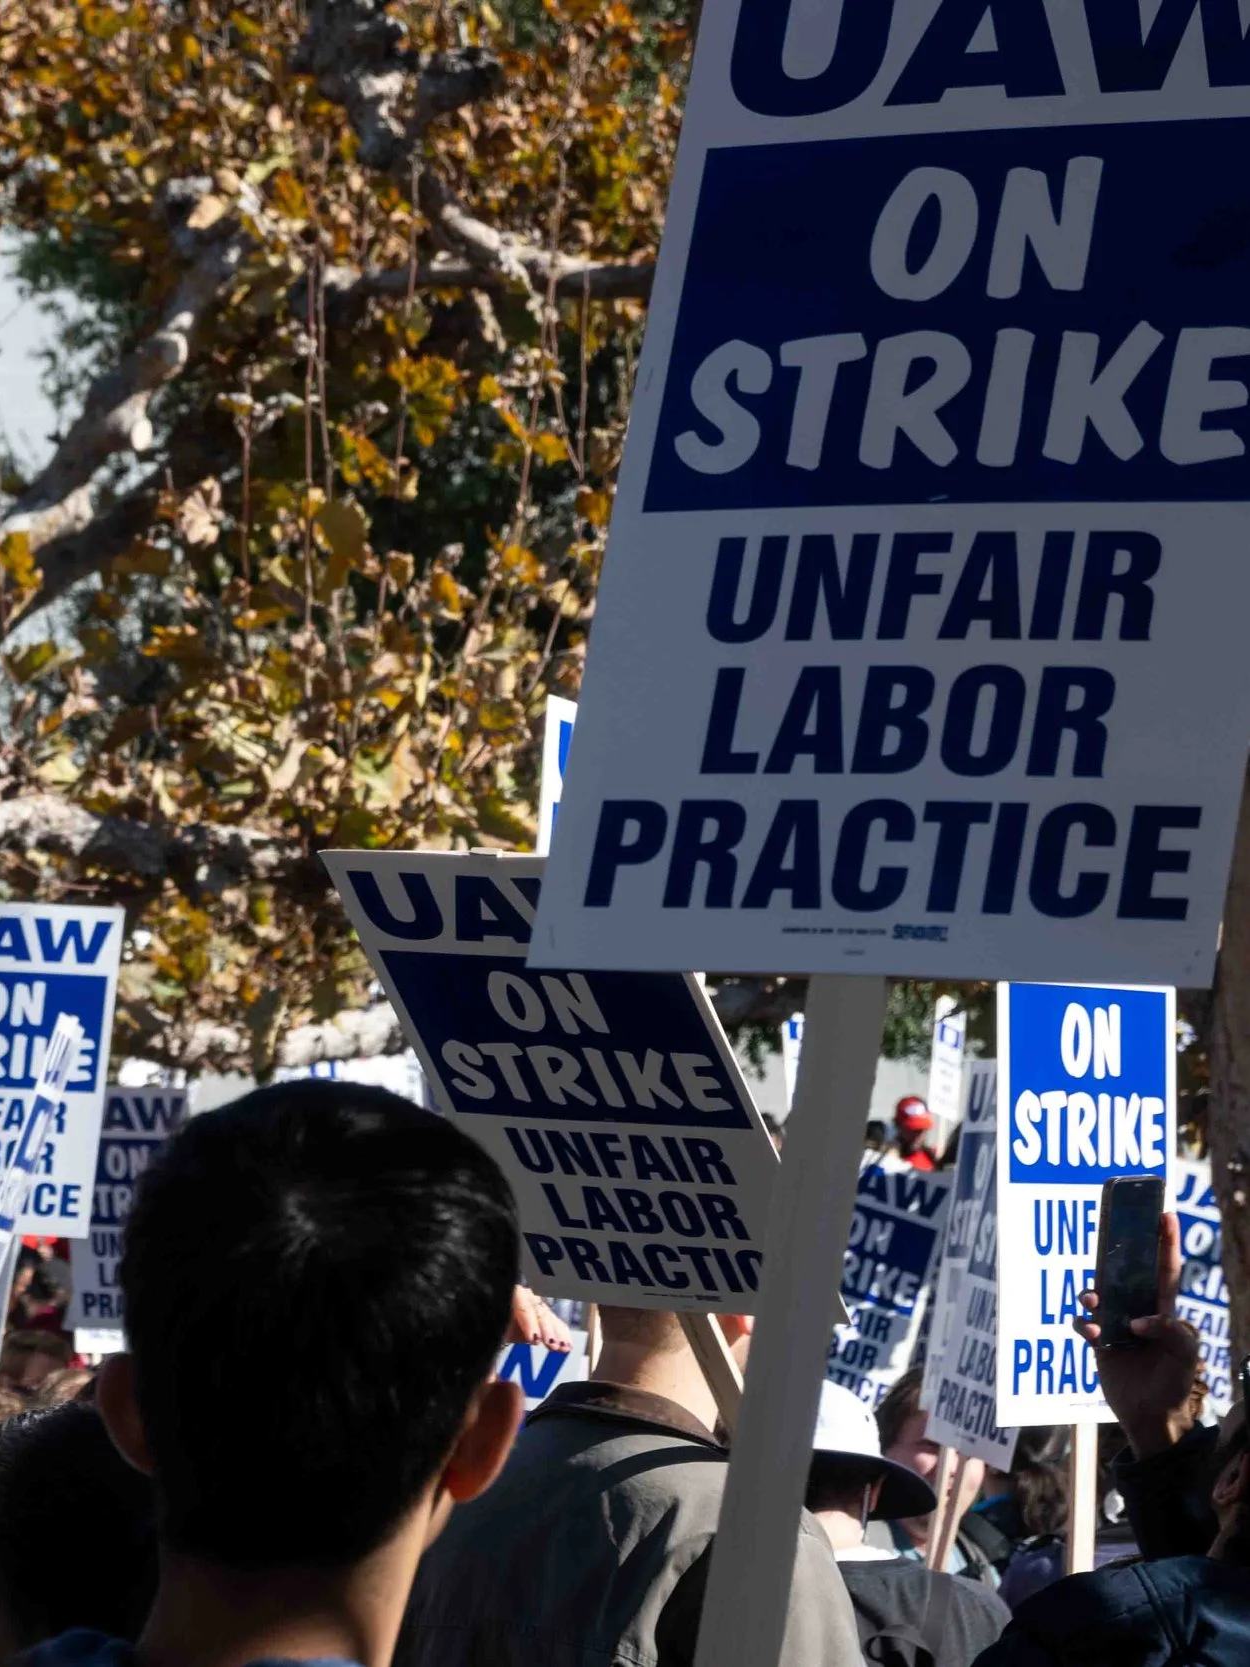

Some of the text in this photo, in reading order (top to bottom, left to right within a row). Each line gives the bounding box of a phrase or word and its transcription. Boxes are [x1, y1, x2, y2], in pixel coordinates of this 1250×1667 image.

[869, 156, 1104, 301] ON
[674, 320, 1250, 474] STRIKE
[705, 530, 1163, 644] UNFAIR
[699, 664, 1116, 778] LABOR
[583, 798, 1203, 920] PRACTICE
[347, 870, 543, 942] UA
[487, 970, 610, 1036] ON
[1060, 1002, 1122, 1080] ON
[442, 1039, 736, 1115] STRIKE
[102, 1096, 187, 1133] AW
[1013, 1089, 1165, 1168] STRIKE
[504, 1127, 738, 1186] UNFAIR
[541, 1182, 752, 1241] LABOR
[856, 1164, 948, 1220] AW
[1034, 1199, 1097, 1256] UNF
[522, 1232, 764, 1293] PRACTIC
[842, 1251, 922, 1306] RIKE
[1013, 1338, 1100, 1396] PRAC
